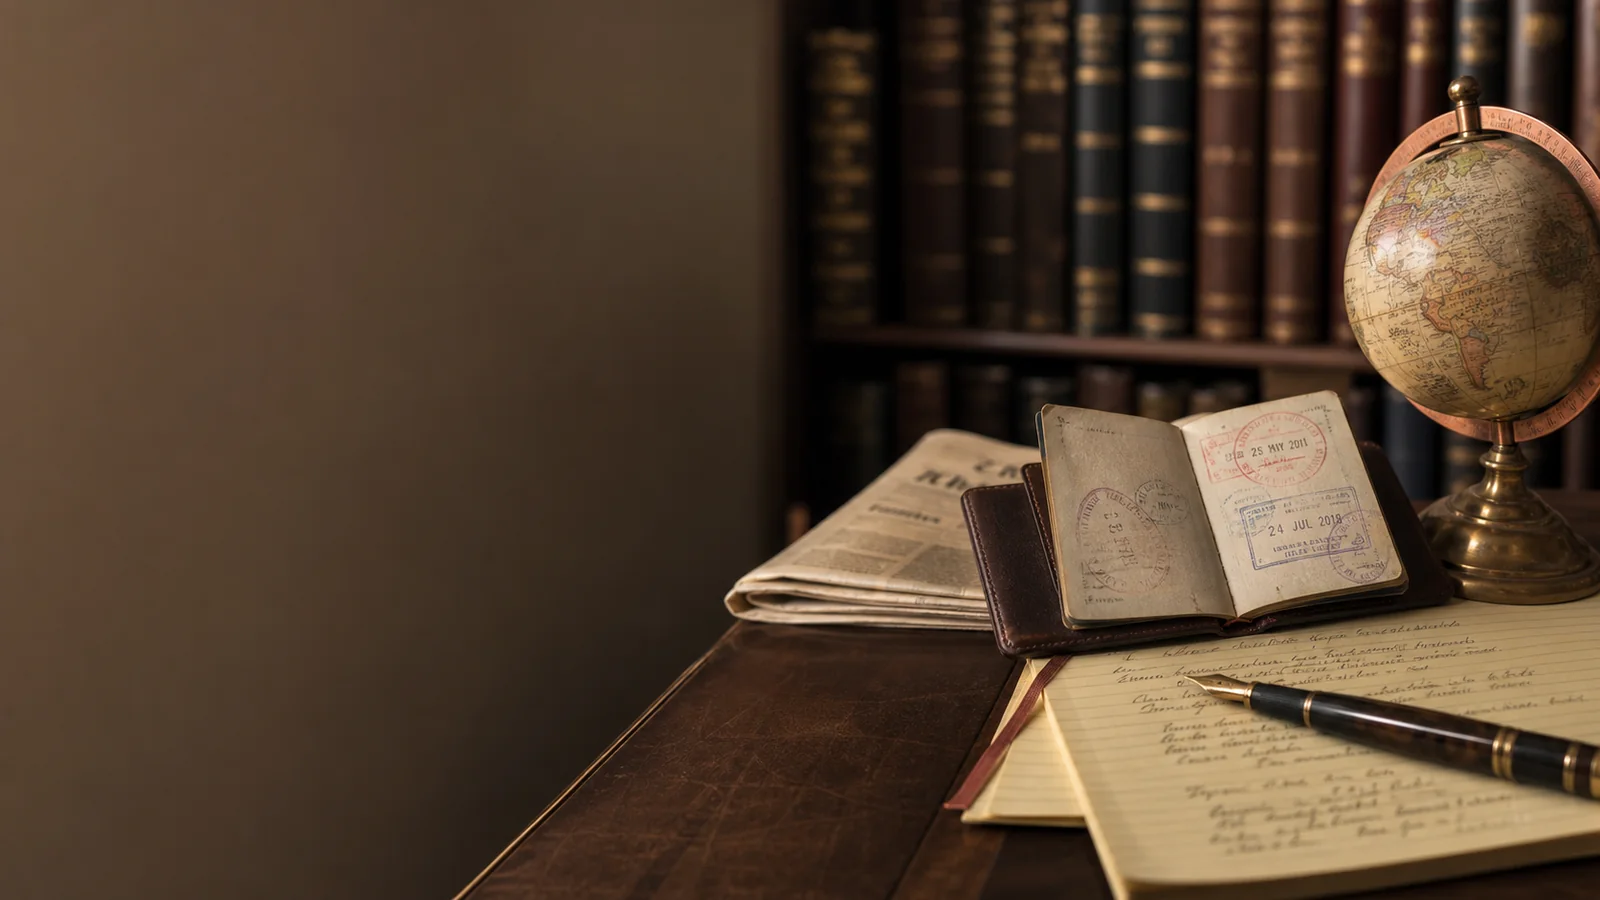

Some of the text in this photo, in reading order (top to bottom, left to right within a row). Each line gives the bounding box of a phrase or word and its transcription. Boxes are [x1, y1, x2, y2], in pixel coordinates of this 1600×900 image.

[1251, 446, 1264, 457] 25
[1288, 438, 1308, 450] 2011
[1268, 523, 1284, 537] 24
[1292, 518, 1313, 532] JUL
